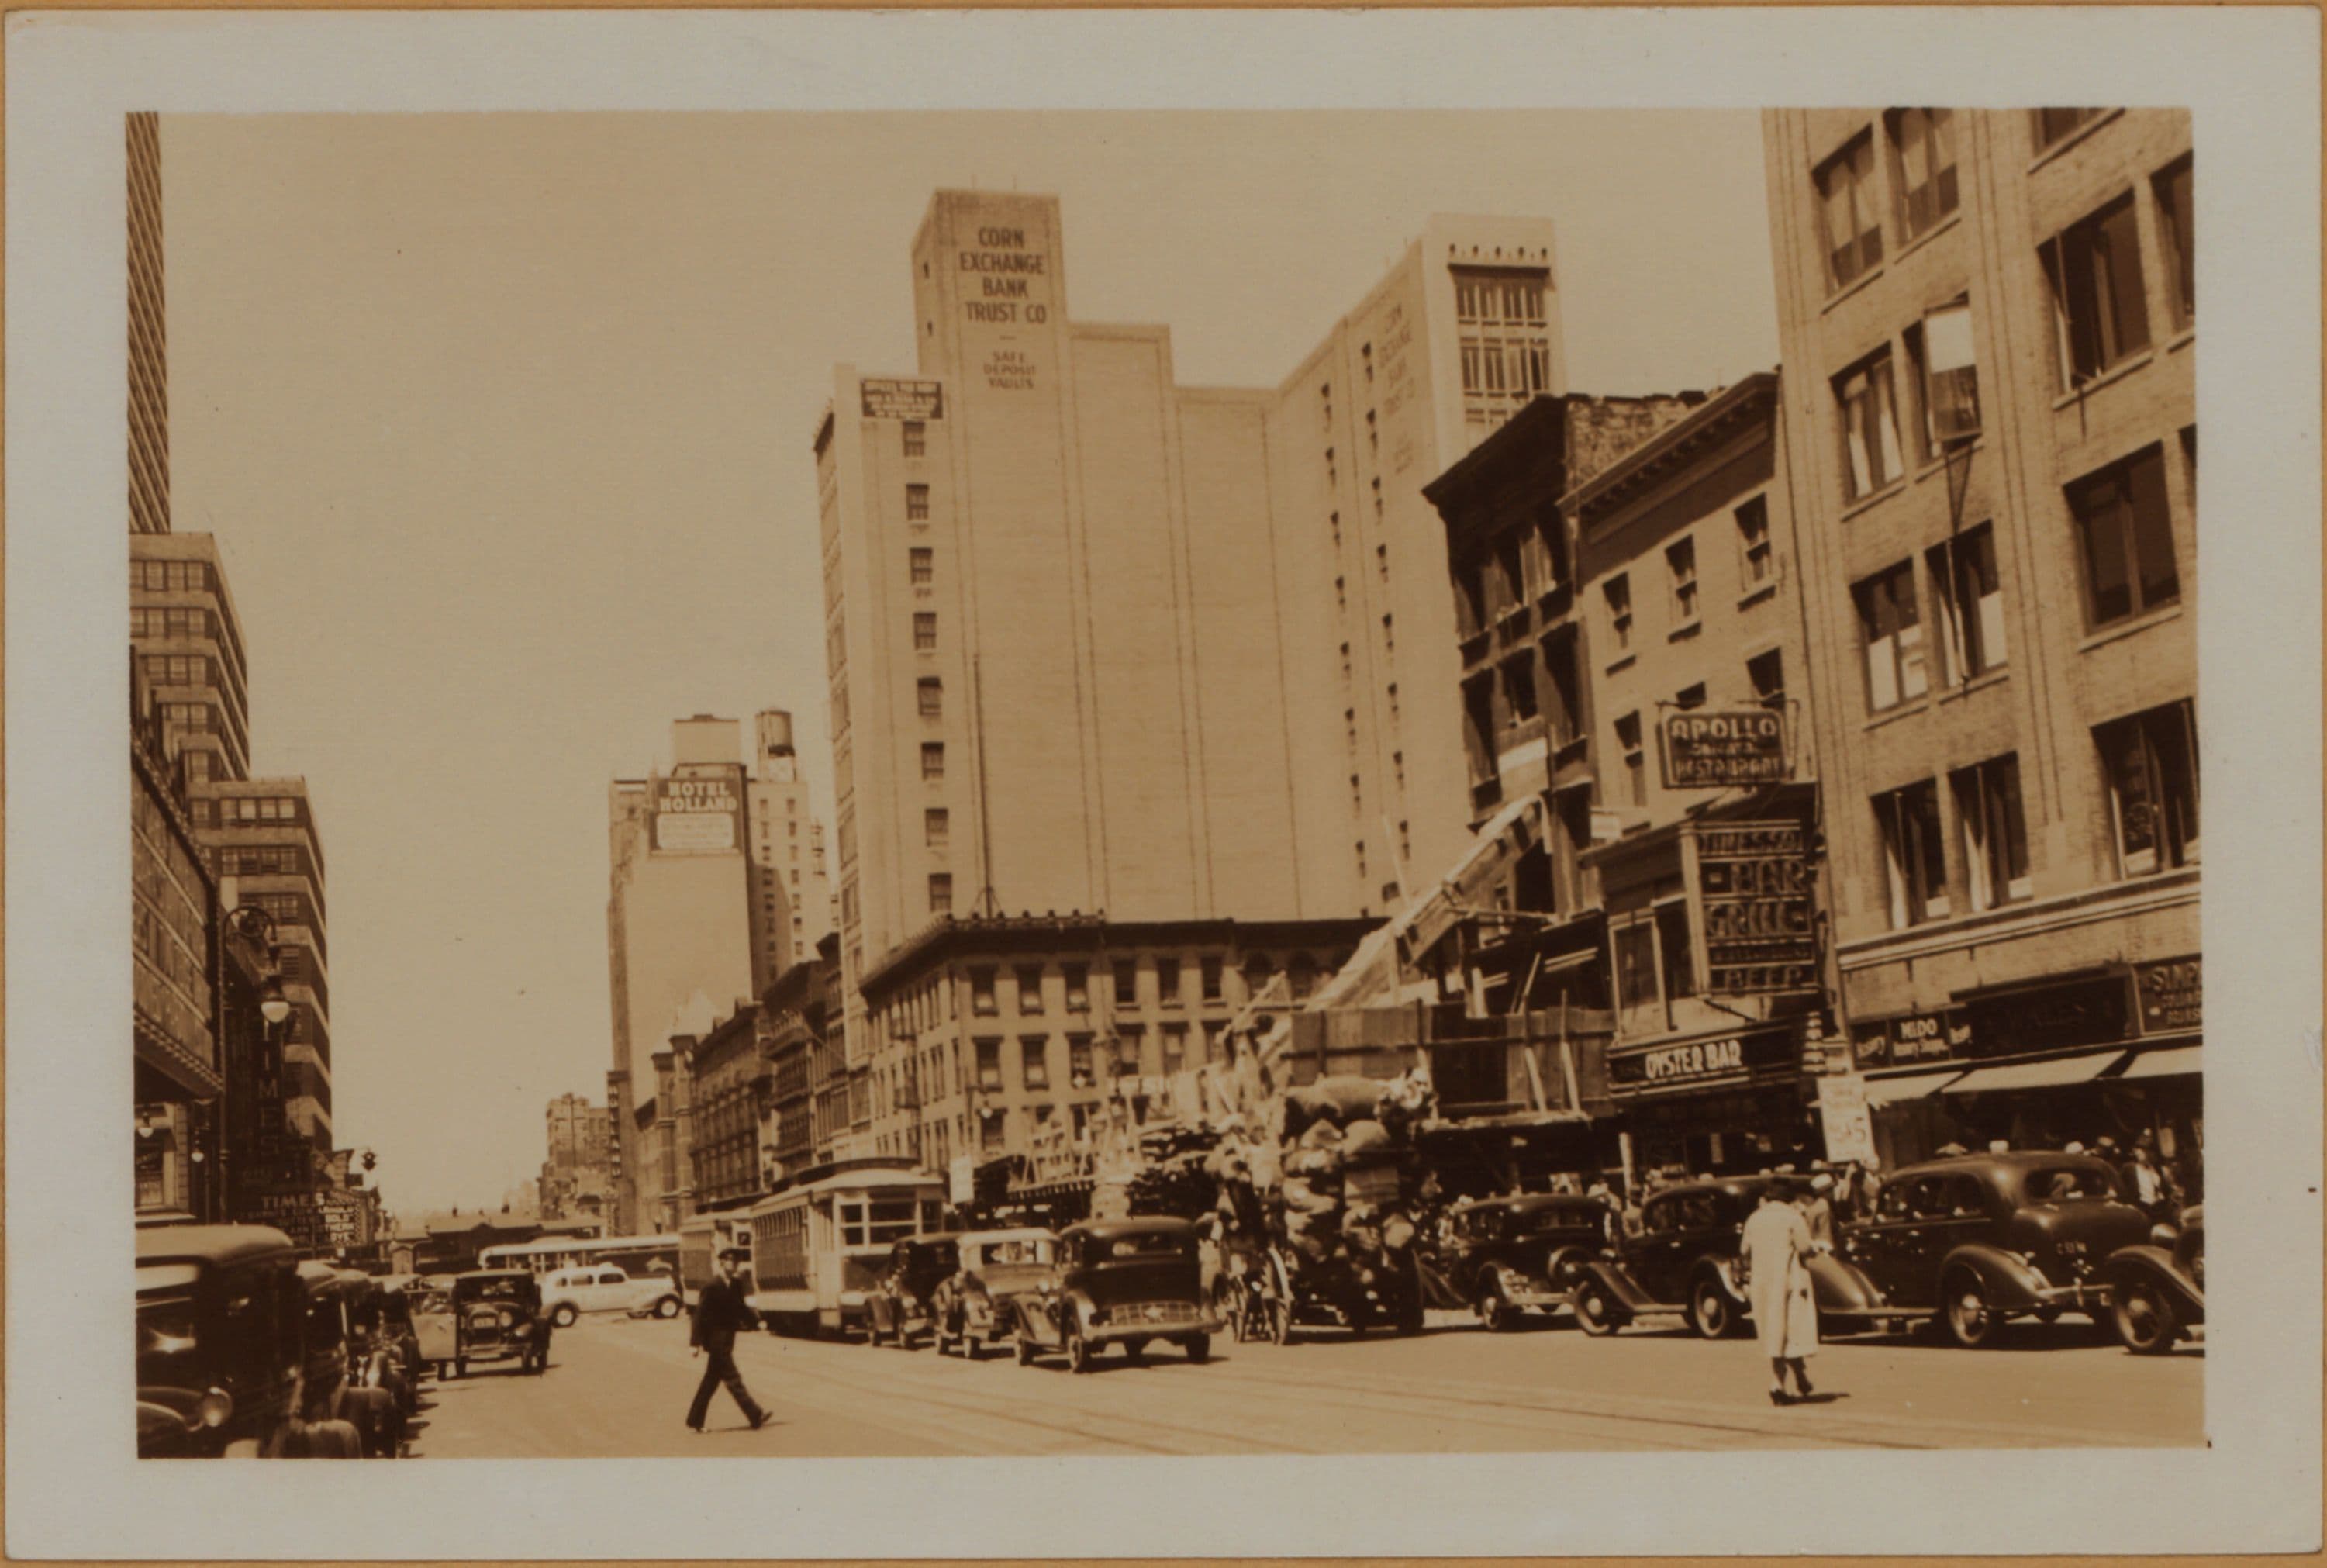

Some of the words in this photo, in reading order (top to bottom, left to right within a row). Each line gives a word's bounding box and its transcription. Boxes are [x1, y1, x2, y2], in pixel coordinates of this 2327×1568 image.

[978, 227, 1025, 249] CORN
[959, 252, 1044, 275] EXCHANGE
[982, 277, 1029, 298] BANK
[965, 302, 1017, 323] TRUST
[1026, 303, 1047, 324] CO
[983, 364, 1037, 375] DEPOSIT
[988, 378, 1034, 390] VAULTS
[1670, 718, 1777, 741] APOLLO
[668, 782, 730, 796] HOTEL
[660, 797, 738, 813] HOLLAND
[1731, 861, 1807, 894] BAR
[1645, 1045, 1704, 1079] OYSTER
[1704, 1040, 1743, 1071] BAR
